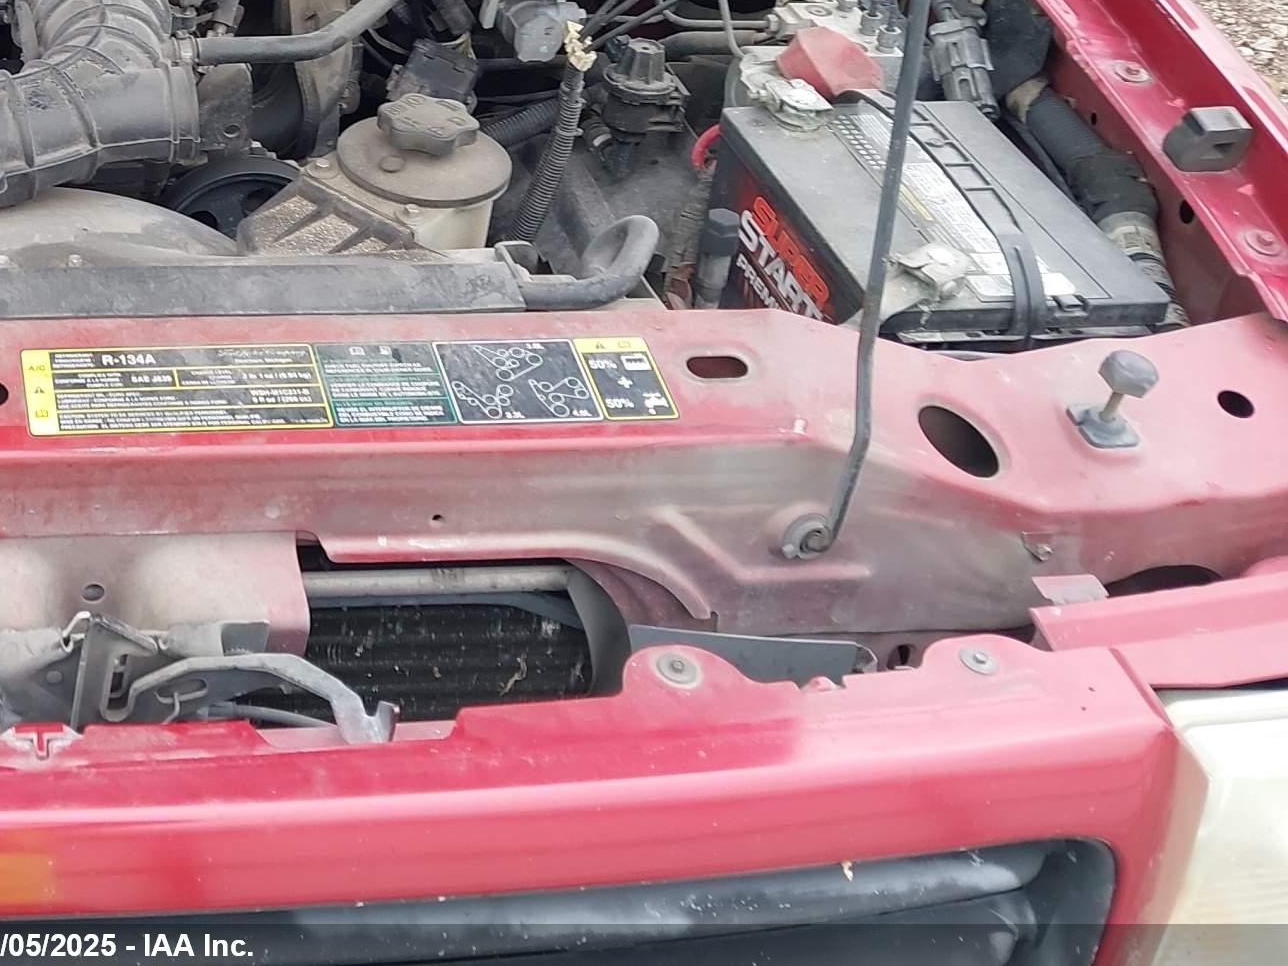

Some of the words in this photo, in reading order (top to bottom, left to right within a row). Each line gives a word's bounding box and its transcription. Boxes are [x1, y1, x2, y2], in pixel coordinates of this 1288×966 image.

[752, 196, 829, 310] SUPER
[738, 210, 823, 321] START
[101, 353, 157, 366] R-134A
[588, 359, 618, 369] 50%
[606, 398, 635, 409] 50%
